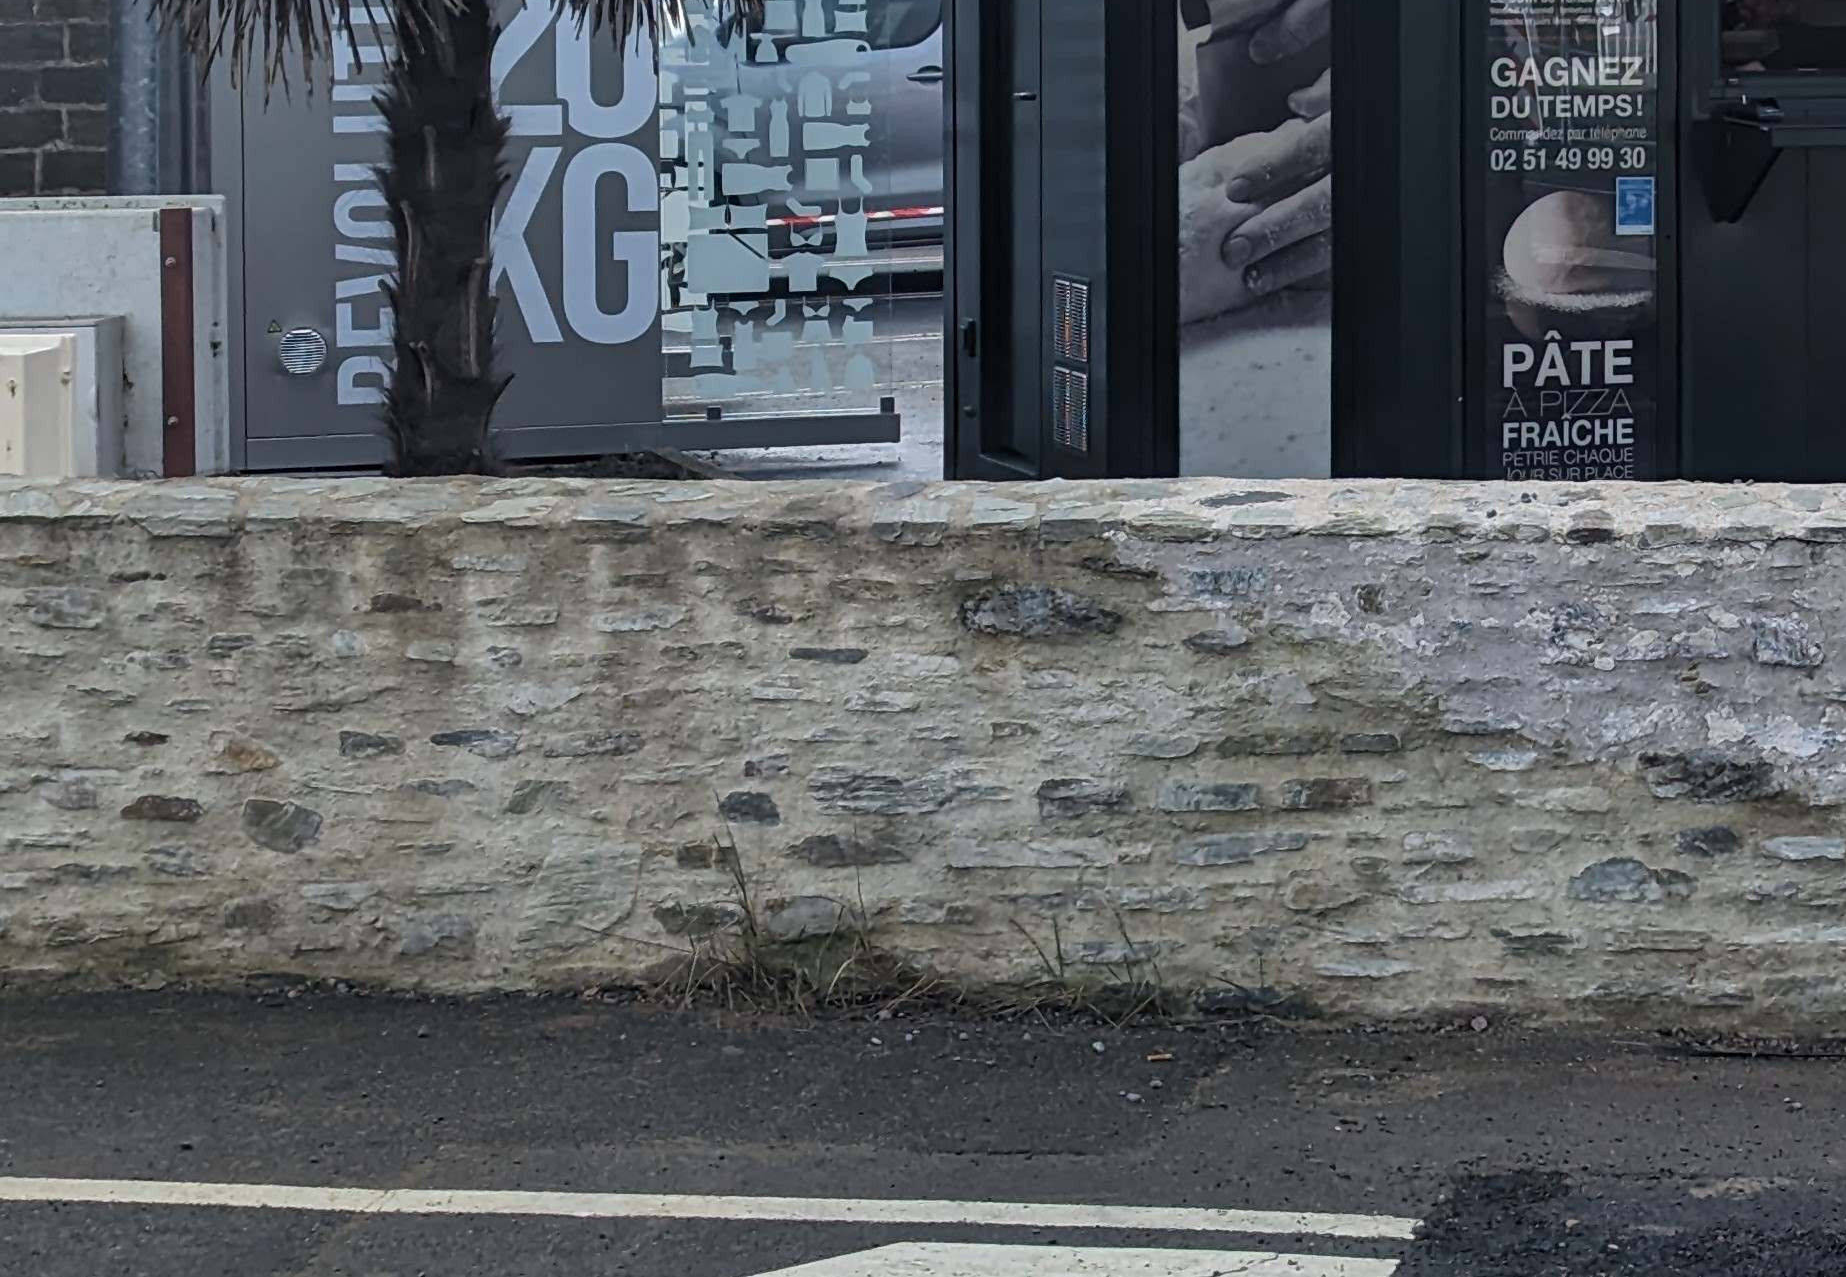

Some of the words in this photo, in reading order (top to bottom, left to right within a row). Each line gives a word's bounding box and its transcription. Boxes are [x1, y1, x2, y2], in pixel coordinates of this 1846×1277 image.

[1490, 56, 1643, 87] GAGNEZ
[1491, 95, 1531, 118] DU
[1490, 149, 1517, 170] 02
[1523, 148, 1546, 170] 51
[1555, 147, 1582, 170] 49
[1587, 147, 1614, 170] 99
[1619, 146, 1646, 169] 30
[489, 142, 660, 346] KG
[1503, 330, 1634, 388] PÂTE
[1502, 386, 1527, 418] À
[1540, 388, 1633, 417] PIZZA
[1502, 413, 1634, 449] FRAÎCHE
[1563, 447, 1634, 465] CHAQUE
[1548, 467, 1581, 480] SUR
[1584, 464, 1634, 480] PLACE
